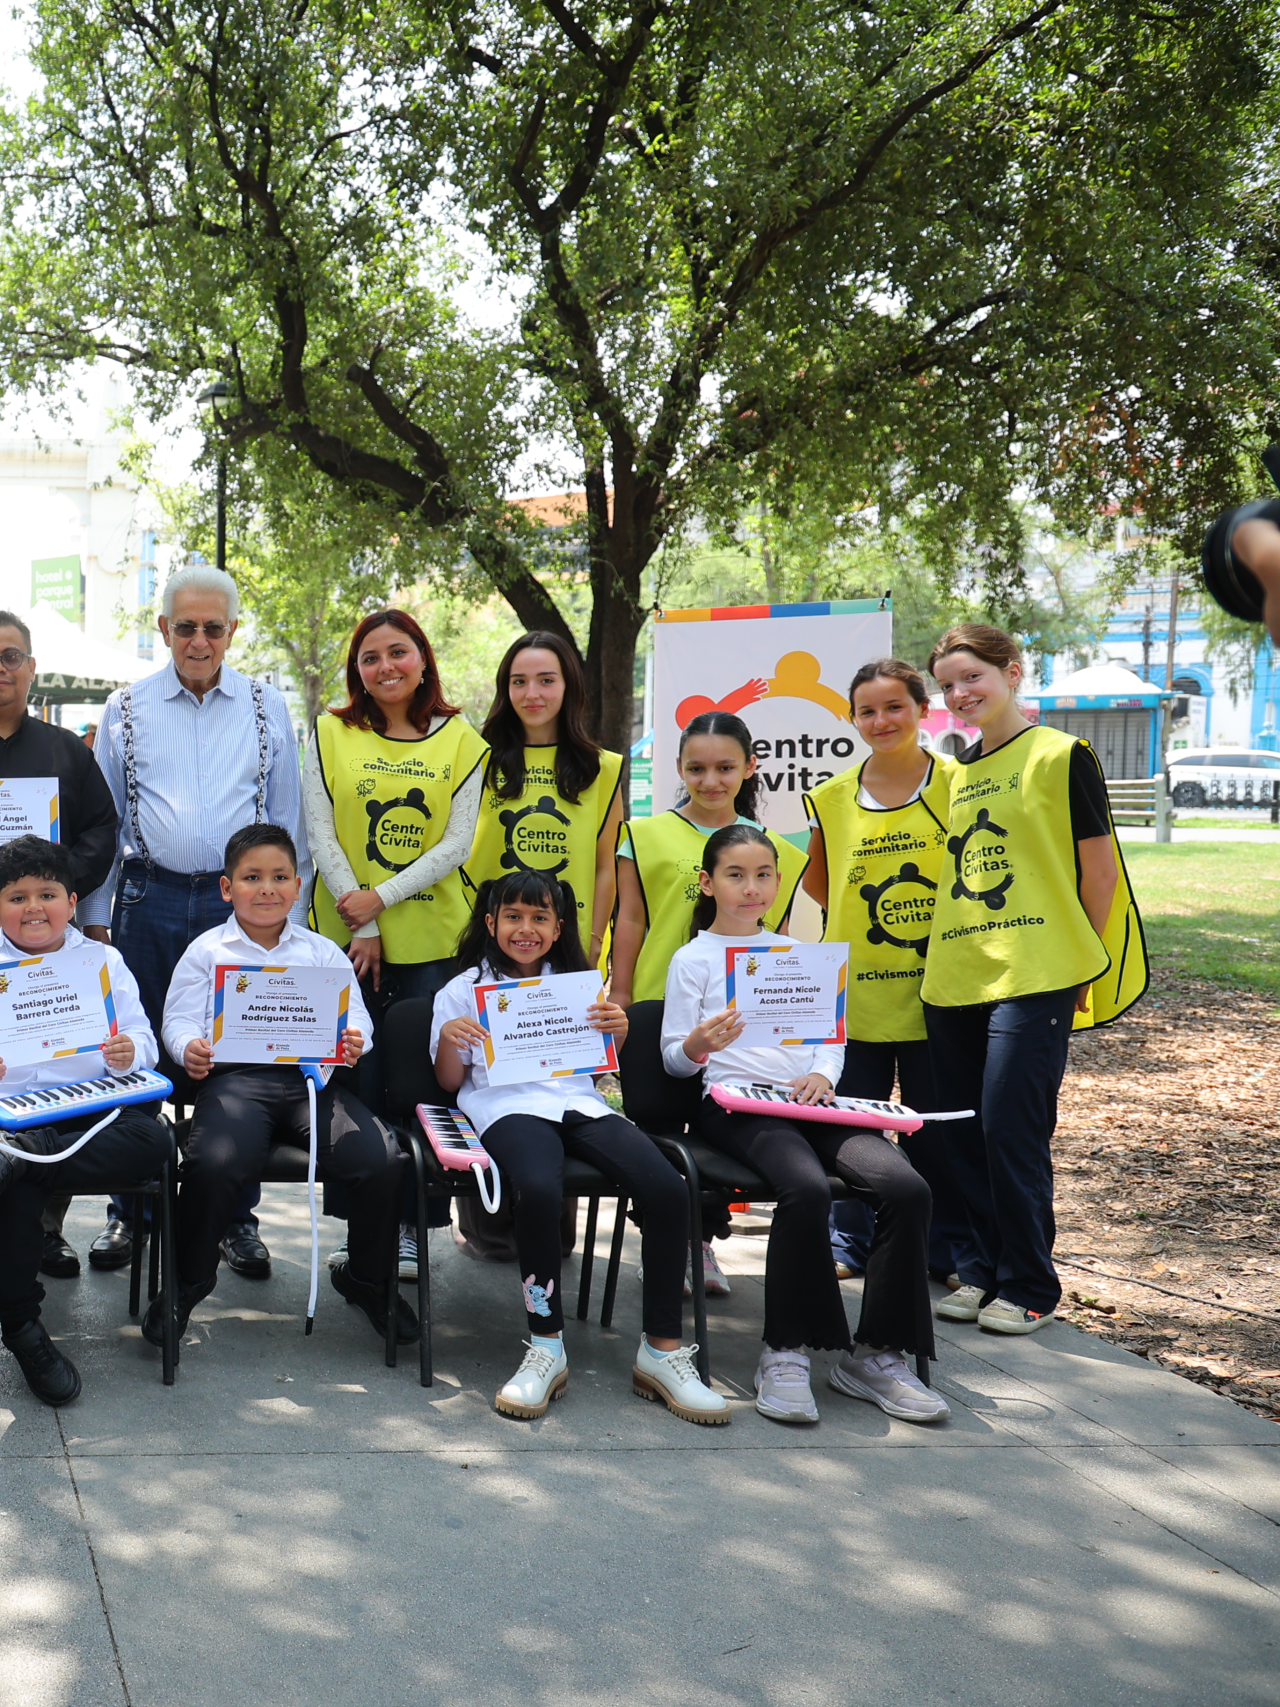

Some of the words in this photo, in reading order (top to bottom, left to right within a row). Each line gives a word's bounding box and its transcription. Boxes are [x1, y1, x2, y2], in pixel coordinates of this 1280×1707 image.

[36, 569, 62, 583] hotel
[36, 585, 73, 600] parque
[50, 598, 74, 610] ntral
[37, 674, 66, 688] LA
[752, 734, 855, 759] entro
[363, 762, 435, 778] comunitario
[3, 814, 28, 823] Ángel
[517, 826, 567, 841] Centro
[861, 831, 911, 847] Servicio
[852, 839, 926, 857] comunitario
[964, 844, 1005, 863] Centro
[881, 897, 936, 912] Centro
[941, 915, 1044, 941] #CivismoPráctico
[18, 984, 69, 996] RECONOCIMIENTO
[753, 987, 794, 995] Fernanda
[795, 985, 821, 993] Nicole
[12, 999, 54, 1011] Santiago
[56, 993, 78, 1004] Uriel
[759, 997, 788, 1005] Acosta
[789, 995, 815, 1003] Cantú
[16, 1010, 50, 1021] Barrera
[53, 1005, 80, 1014] Cerda
[280, 1005, 314, 1013] Nicolás
[518, 1006, 568, 1016] RECONOCIMIENTO
[242, 1014, 289, 1023] Rodríguez
[291, 1015, 317, 1023] Salas
[517, 1021, 542, 1029] Alexa
[544, 1016, 573, 1025] Nicole
[504, 1030, 543, 1041] Alvarado
[546, 1024, 590, 1035] Castrejón
